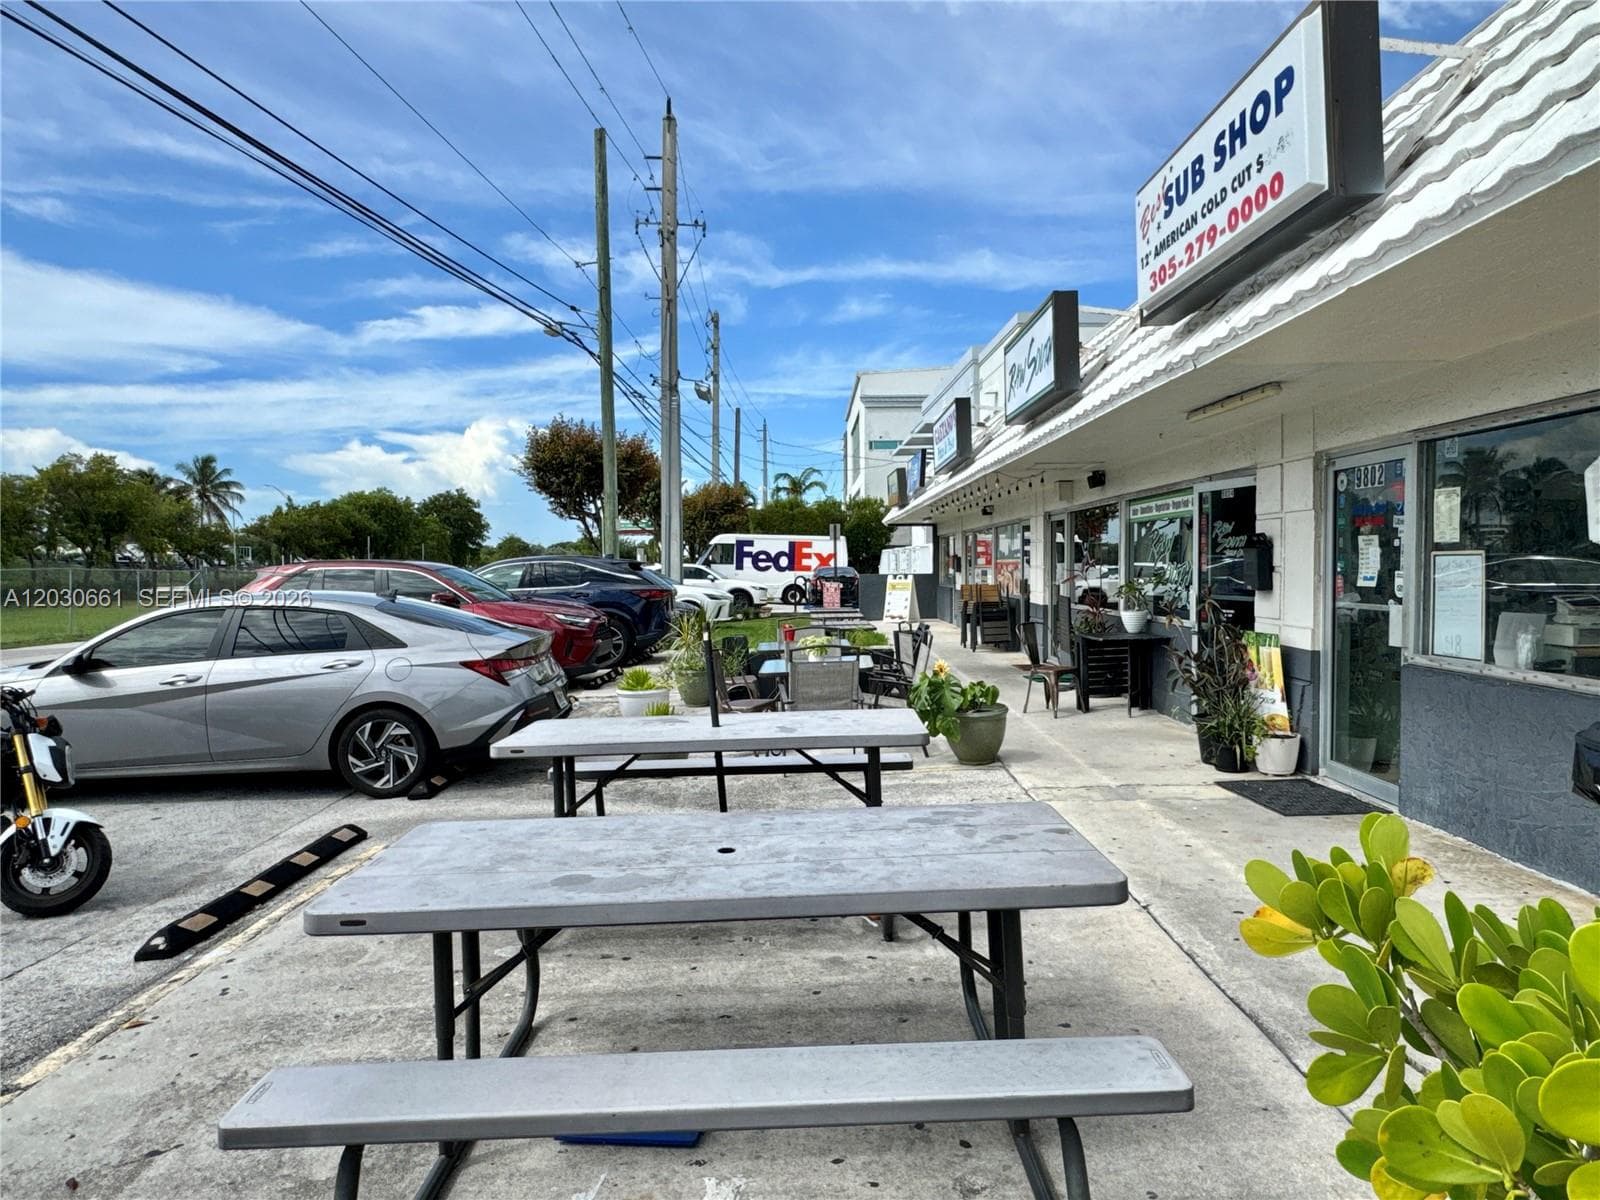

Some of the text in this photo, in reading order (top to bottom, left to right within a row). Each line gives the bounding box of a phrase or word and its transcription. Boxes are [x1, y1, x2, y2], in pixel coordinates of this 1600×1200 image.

[1163, 153, 1206, 219] SUB
[1213, 65, 1295, 173] SHOP
[1149, 170, 1285, 293] 305-279-0000
[1153, 210, 1199, 260] AMERICAN
[1200, 186, 1228, 220] COLD
[1231, 168, 1252, 195] CUT
[1356, 464, 1384, 488] 9802
[735, 539, 837, 572] FedEx
